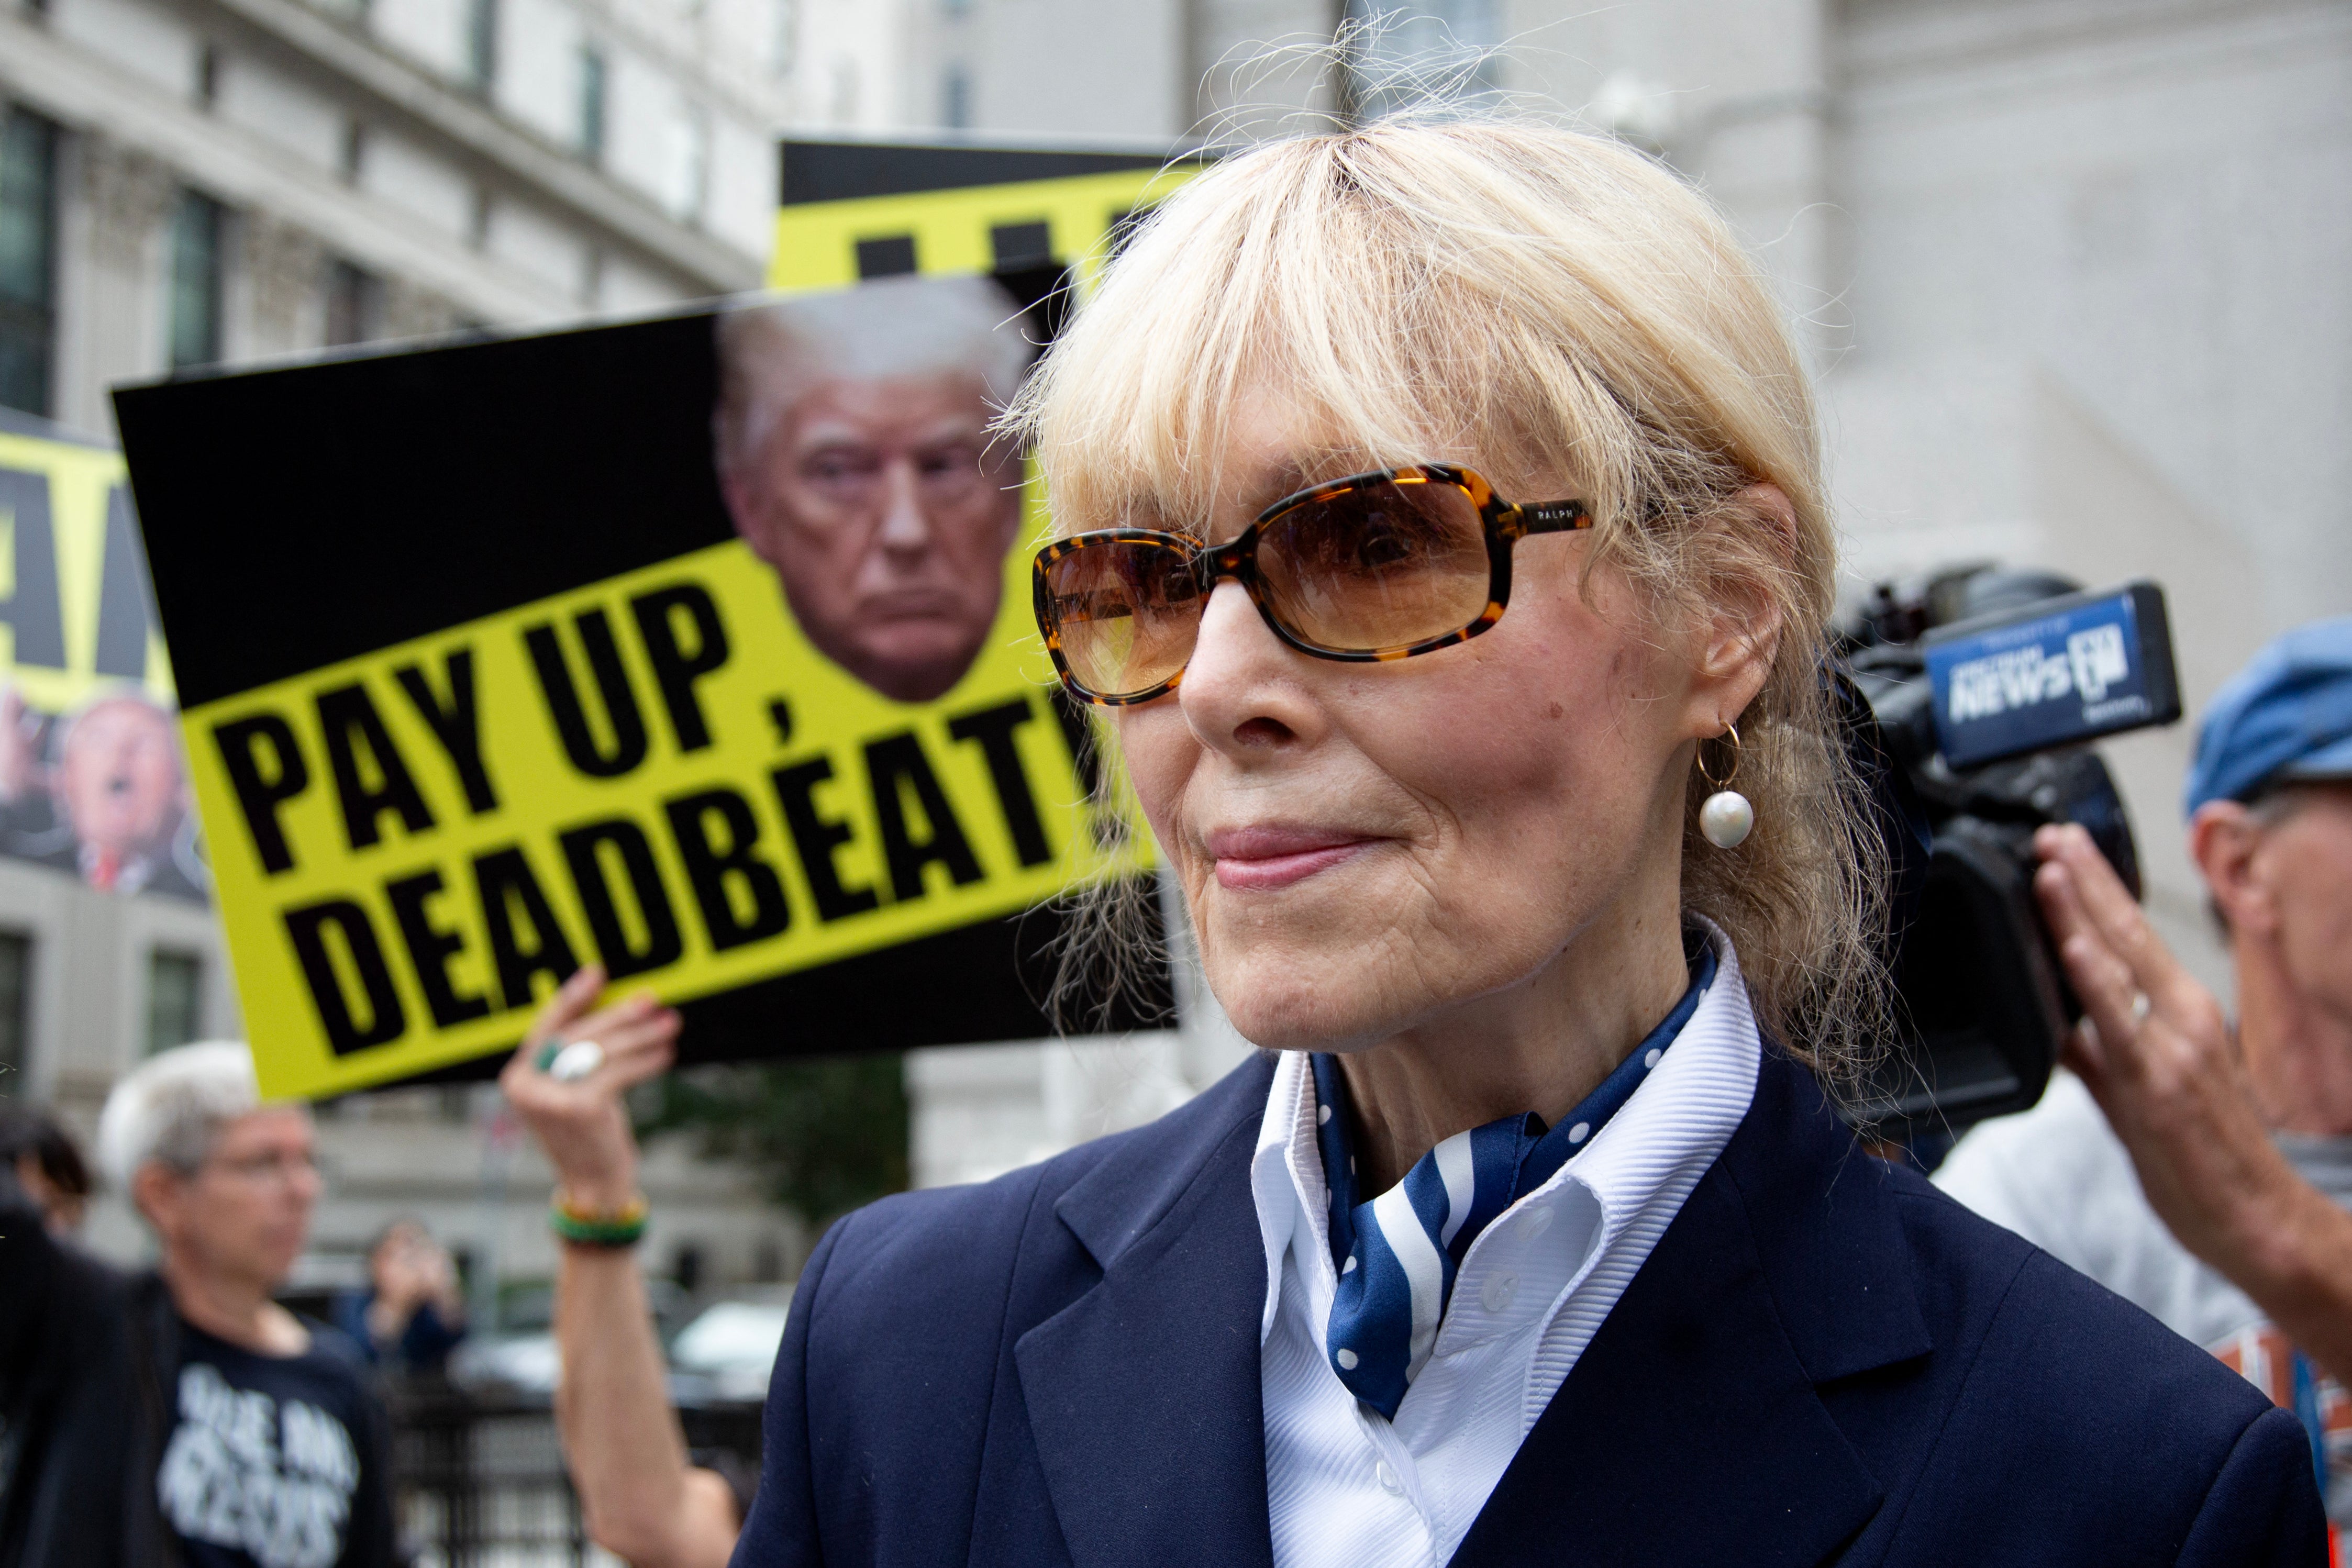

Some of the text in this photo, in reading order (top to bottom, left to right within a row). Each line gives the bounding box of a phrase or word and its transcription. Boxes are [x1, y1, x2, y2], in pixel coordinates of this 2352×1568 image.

[1538, 510, 1573, 520] RALPH
[211, 581, 793, 877] PAY UP,
